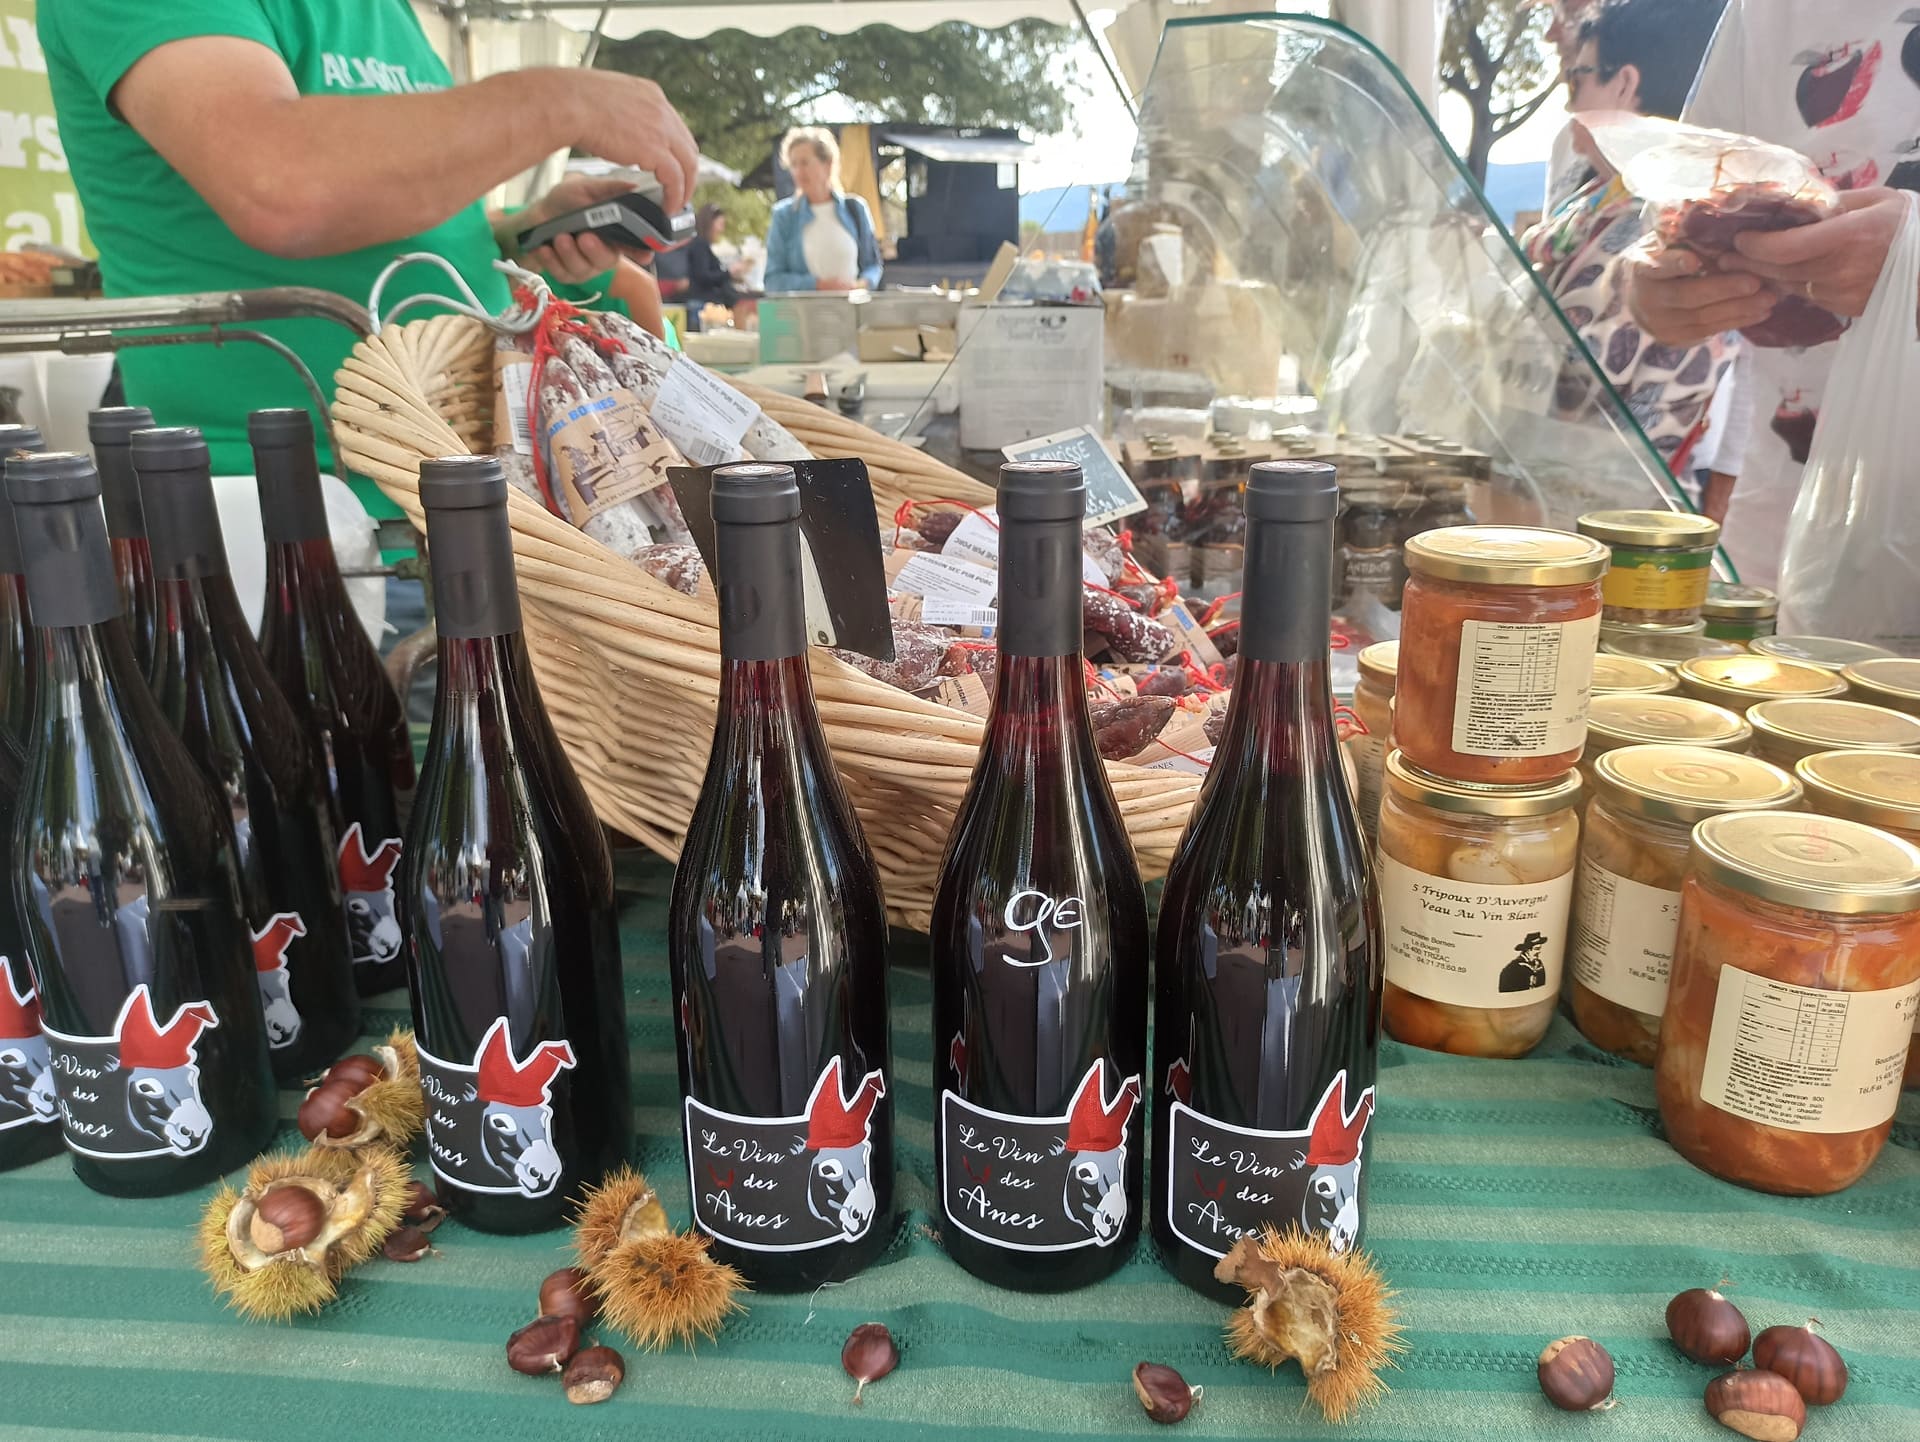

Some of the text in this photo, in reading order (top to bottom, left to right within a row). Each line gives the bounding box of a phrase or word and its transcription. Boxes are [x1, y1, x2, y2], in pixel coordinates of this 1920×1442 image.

[1411, 883, 1419, 892] 5
[1422, 885, 1472, 904] Tripoux
[1420, 898, 1540, 921] Veau Au Vin Blanc
[1661, 904, 1669, 913] 5
[1002, 890, 1085, 968] 9€
[1424, 950, 1450, 963] TRIZAC
[60, 1054, 101, 1079] Vin
[72, 1085, 99, 1102] des
[425, 1074, 461, 1106] Vin
[58, 1098, 114, 1138] Anes
[433, 1109, 457, 1130] des
[701, 1128, 785, 1165] Le Vin
[958, 1123, 1045, 1164] Le Vin
[1189, 1135, 1286, 1179] Le Vin
[743, 1172, 779, 1191] des
[999, 1170, 1036, 1190] des
[957, 1184, 1045, 1231] Anes
[1234, 1185, 1275, 1205] des
[705, 1188, 790, 1230] Anes
[1187, 1199, 1264, 1241] Ane
